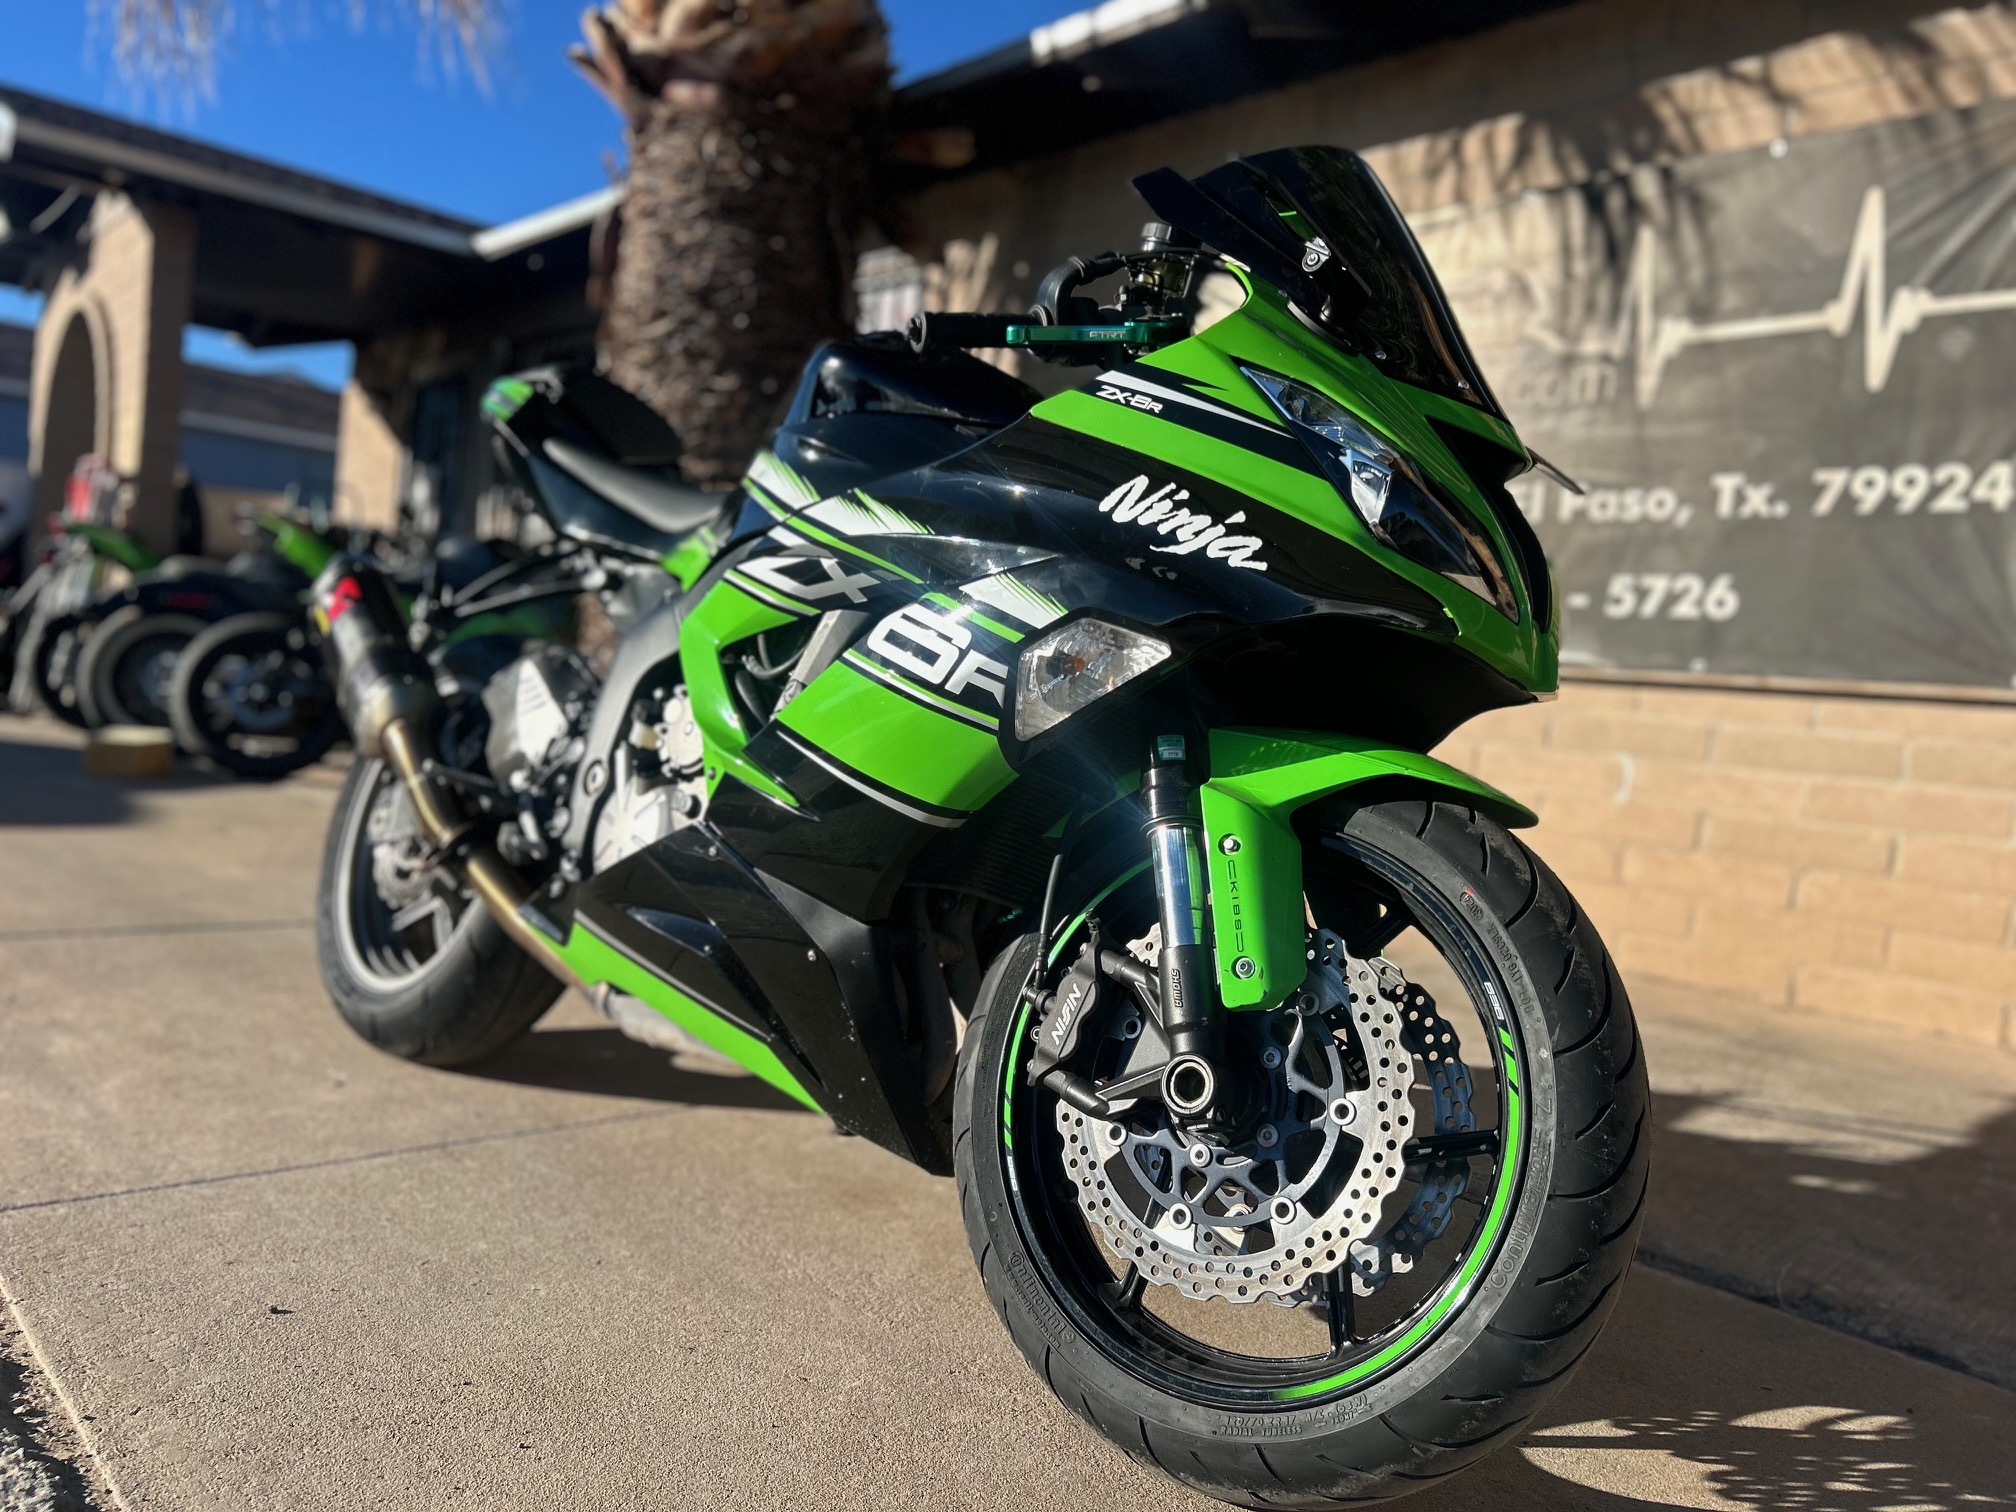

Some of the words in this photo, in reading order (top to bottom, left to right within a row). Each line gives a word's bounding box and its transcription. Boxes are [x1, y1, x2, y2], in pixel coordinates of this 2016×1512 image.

[1096, 384, 1163, 414] ZX-6R
[1709, 472, 1791, 520] Tx.
[1810, 459, 2015, 517] 79924
[1098, 474, 1268, 571] Ninja
[1602, 571, 1742, 622] 5726
[1170, 968, 1183, 1008] SHOWA
[1220, 1425, 1254, 1437] RADIAL
[1261, 1424, 1303, 1437] TUBELESS
